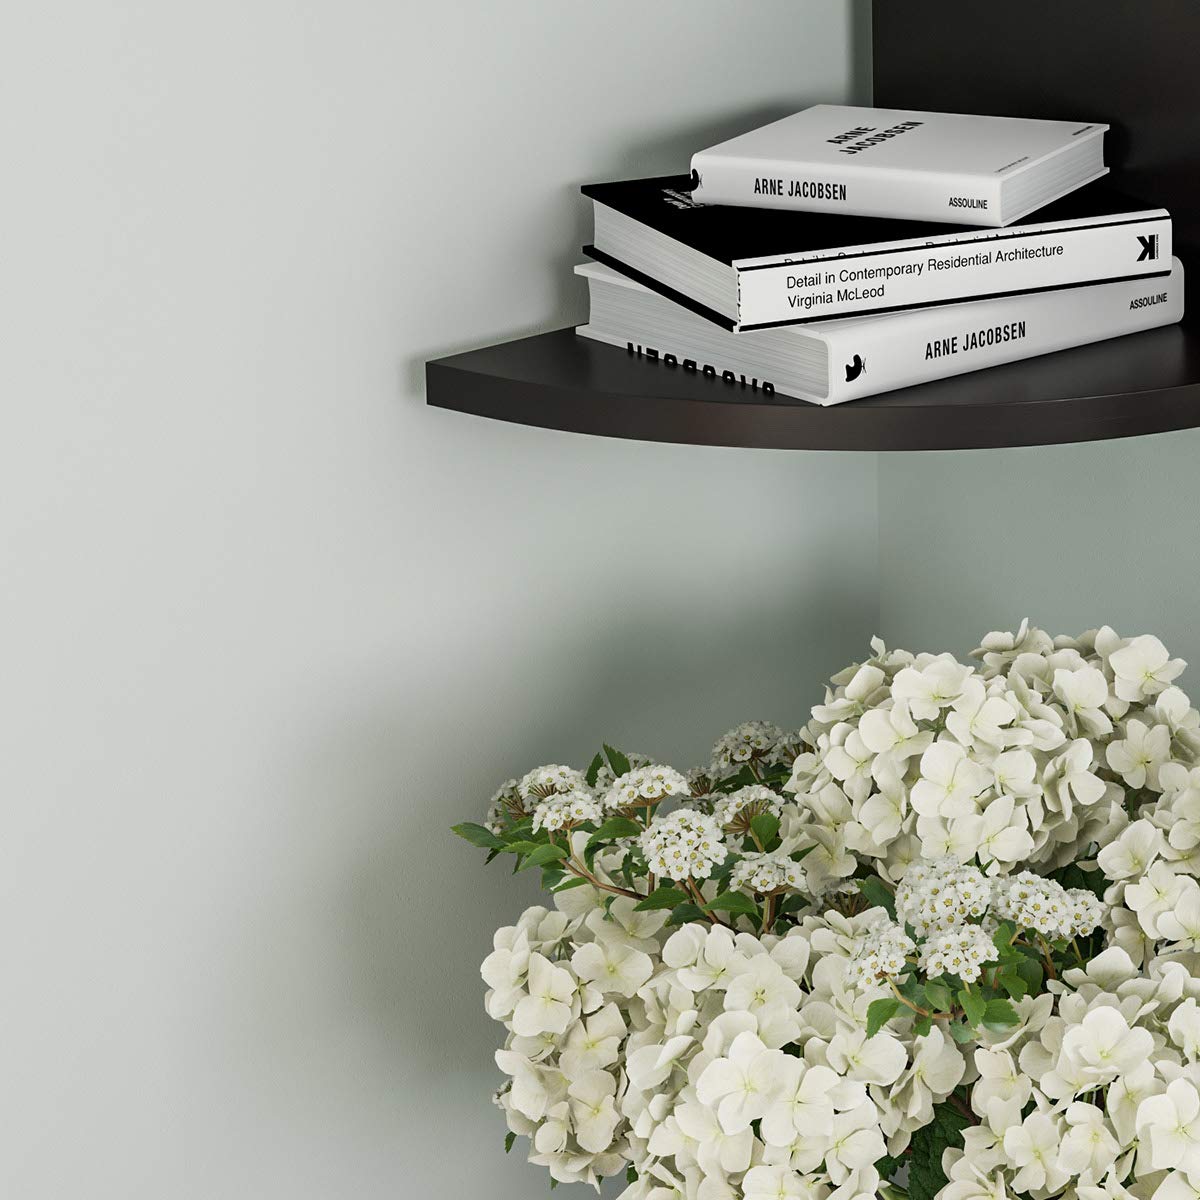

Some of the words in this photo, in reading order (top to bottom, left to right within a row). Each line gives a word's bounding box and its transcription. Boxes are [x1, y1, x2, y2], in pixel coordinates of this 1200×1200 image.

[826, 127, 877, 144] ARNE
[839, 121, 924, 155] JACOBSEN
[754, 178, 783, 196] ARNE
[788, 180, 847, 200] JACOBSEN
[949, 197, 988, 209] ASSOULINE
[787, 272, 821, 289] Detail
[825, 272, 836, 284] in
[840, 263, 924, 282] Contemporary
[928, 252, 992, 271] Residential
[995, 245, 1064, 263] Architecture
[788, 292, 833, 309] Virginia
[837, 284, 885, 303] McLeod
[1129, 292, 1168, 310] ASSOULINE
[925, 336, 958, 360] ARNE
[962, 321, 1026, 351] JACOBSEN
